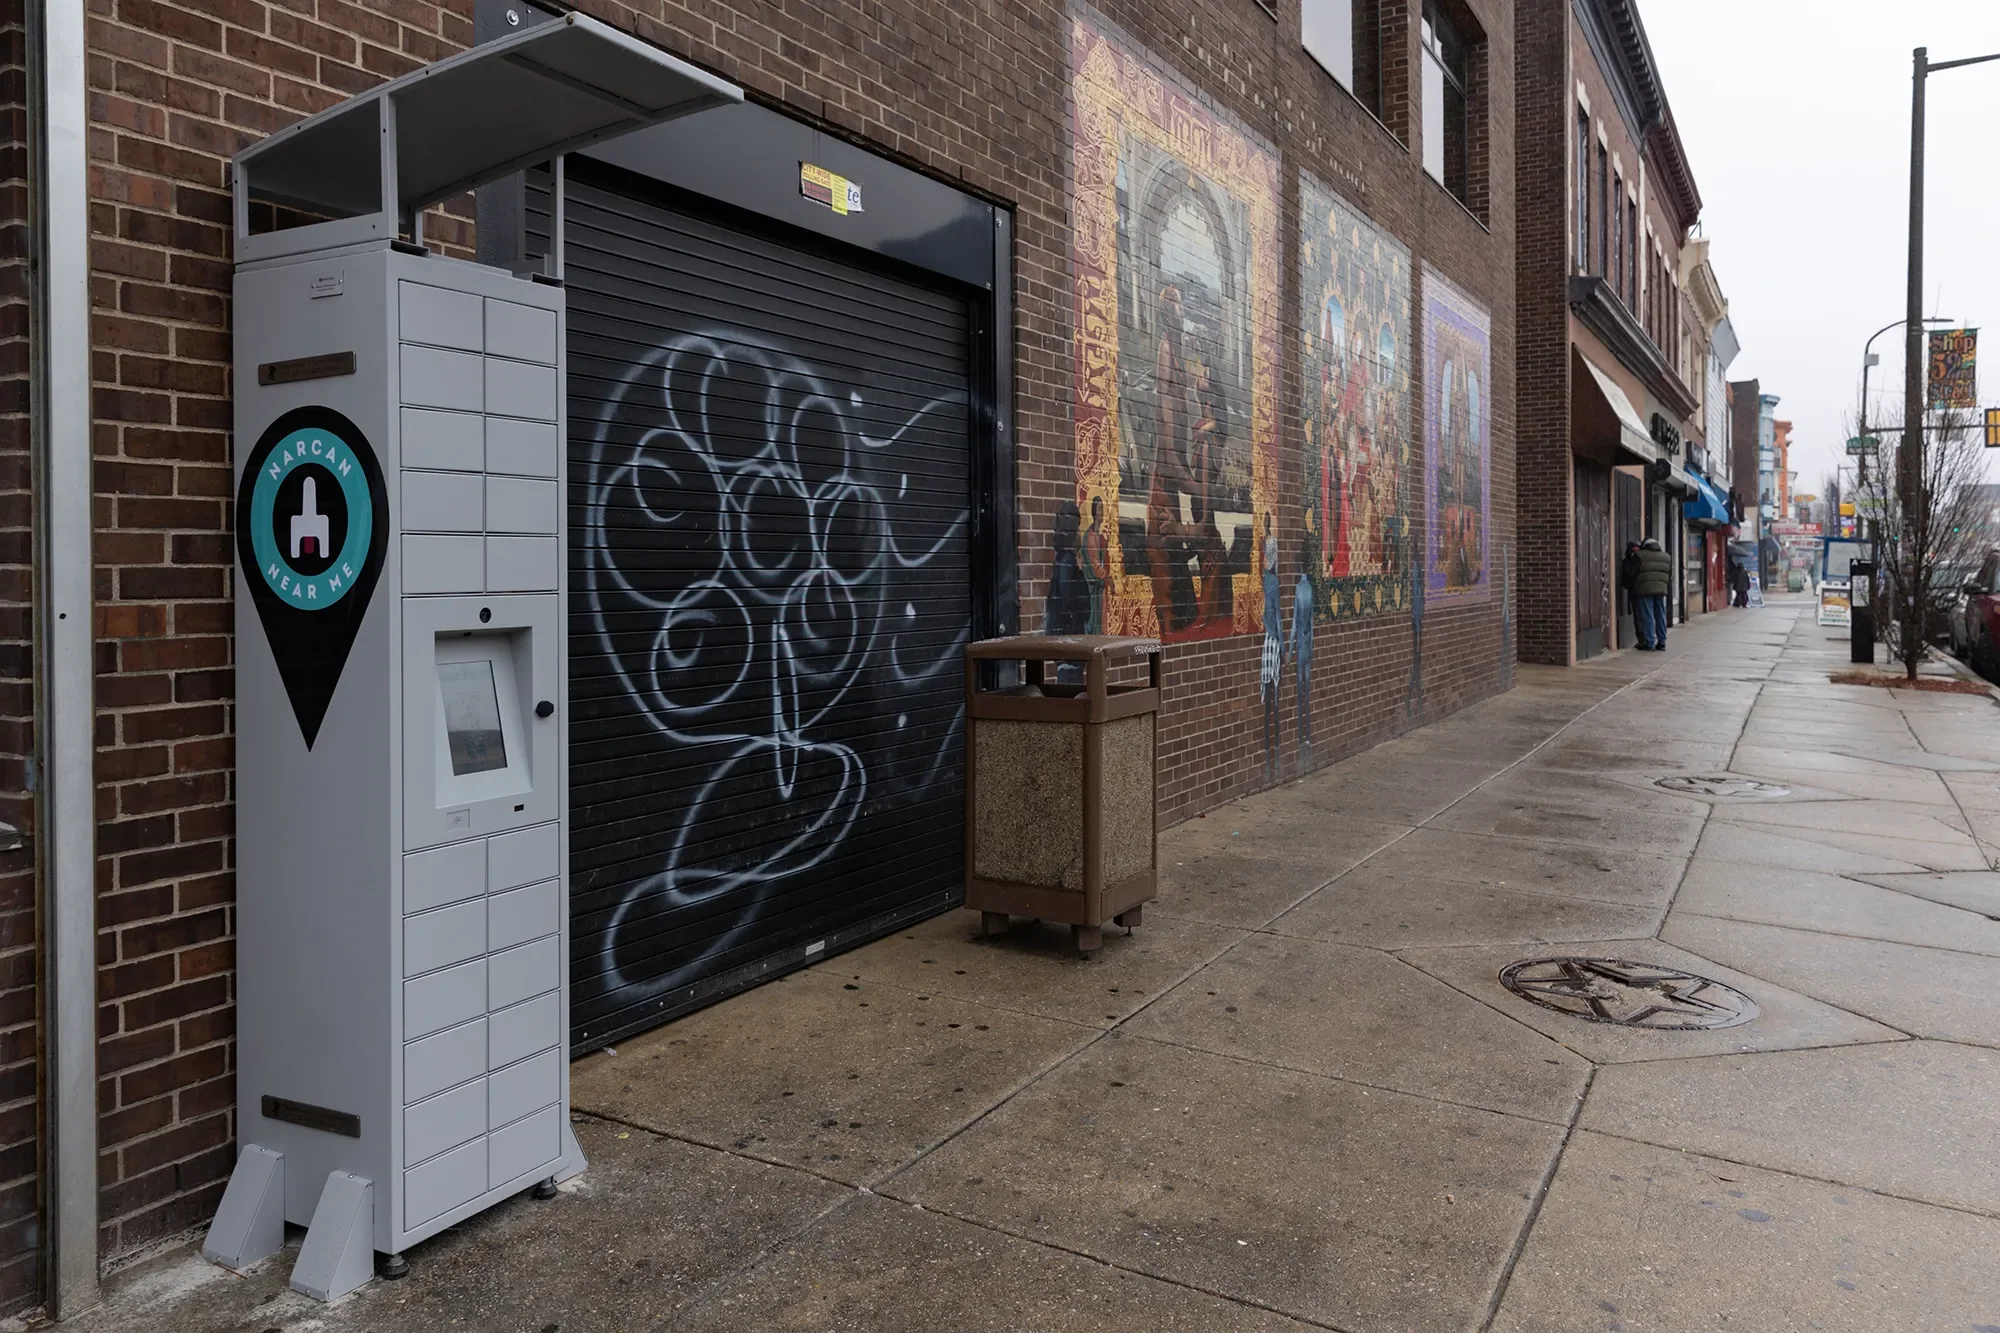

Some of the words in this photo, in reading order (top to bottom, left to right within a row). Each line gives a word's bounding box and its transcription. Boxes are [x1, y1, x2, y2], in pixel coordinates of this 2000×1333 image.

[1930, 334, 1975, 353] Shop
[268, 439, 352, 480] NARCAN
[268, 563, 317, 599] NEAR
[328, 562, 353, 592] ME
